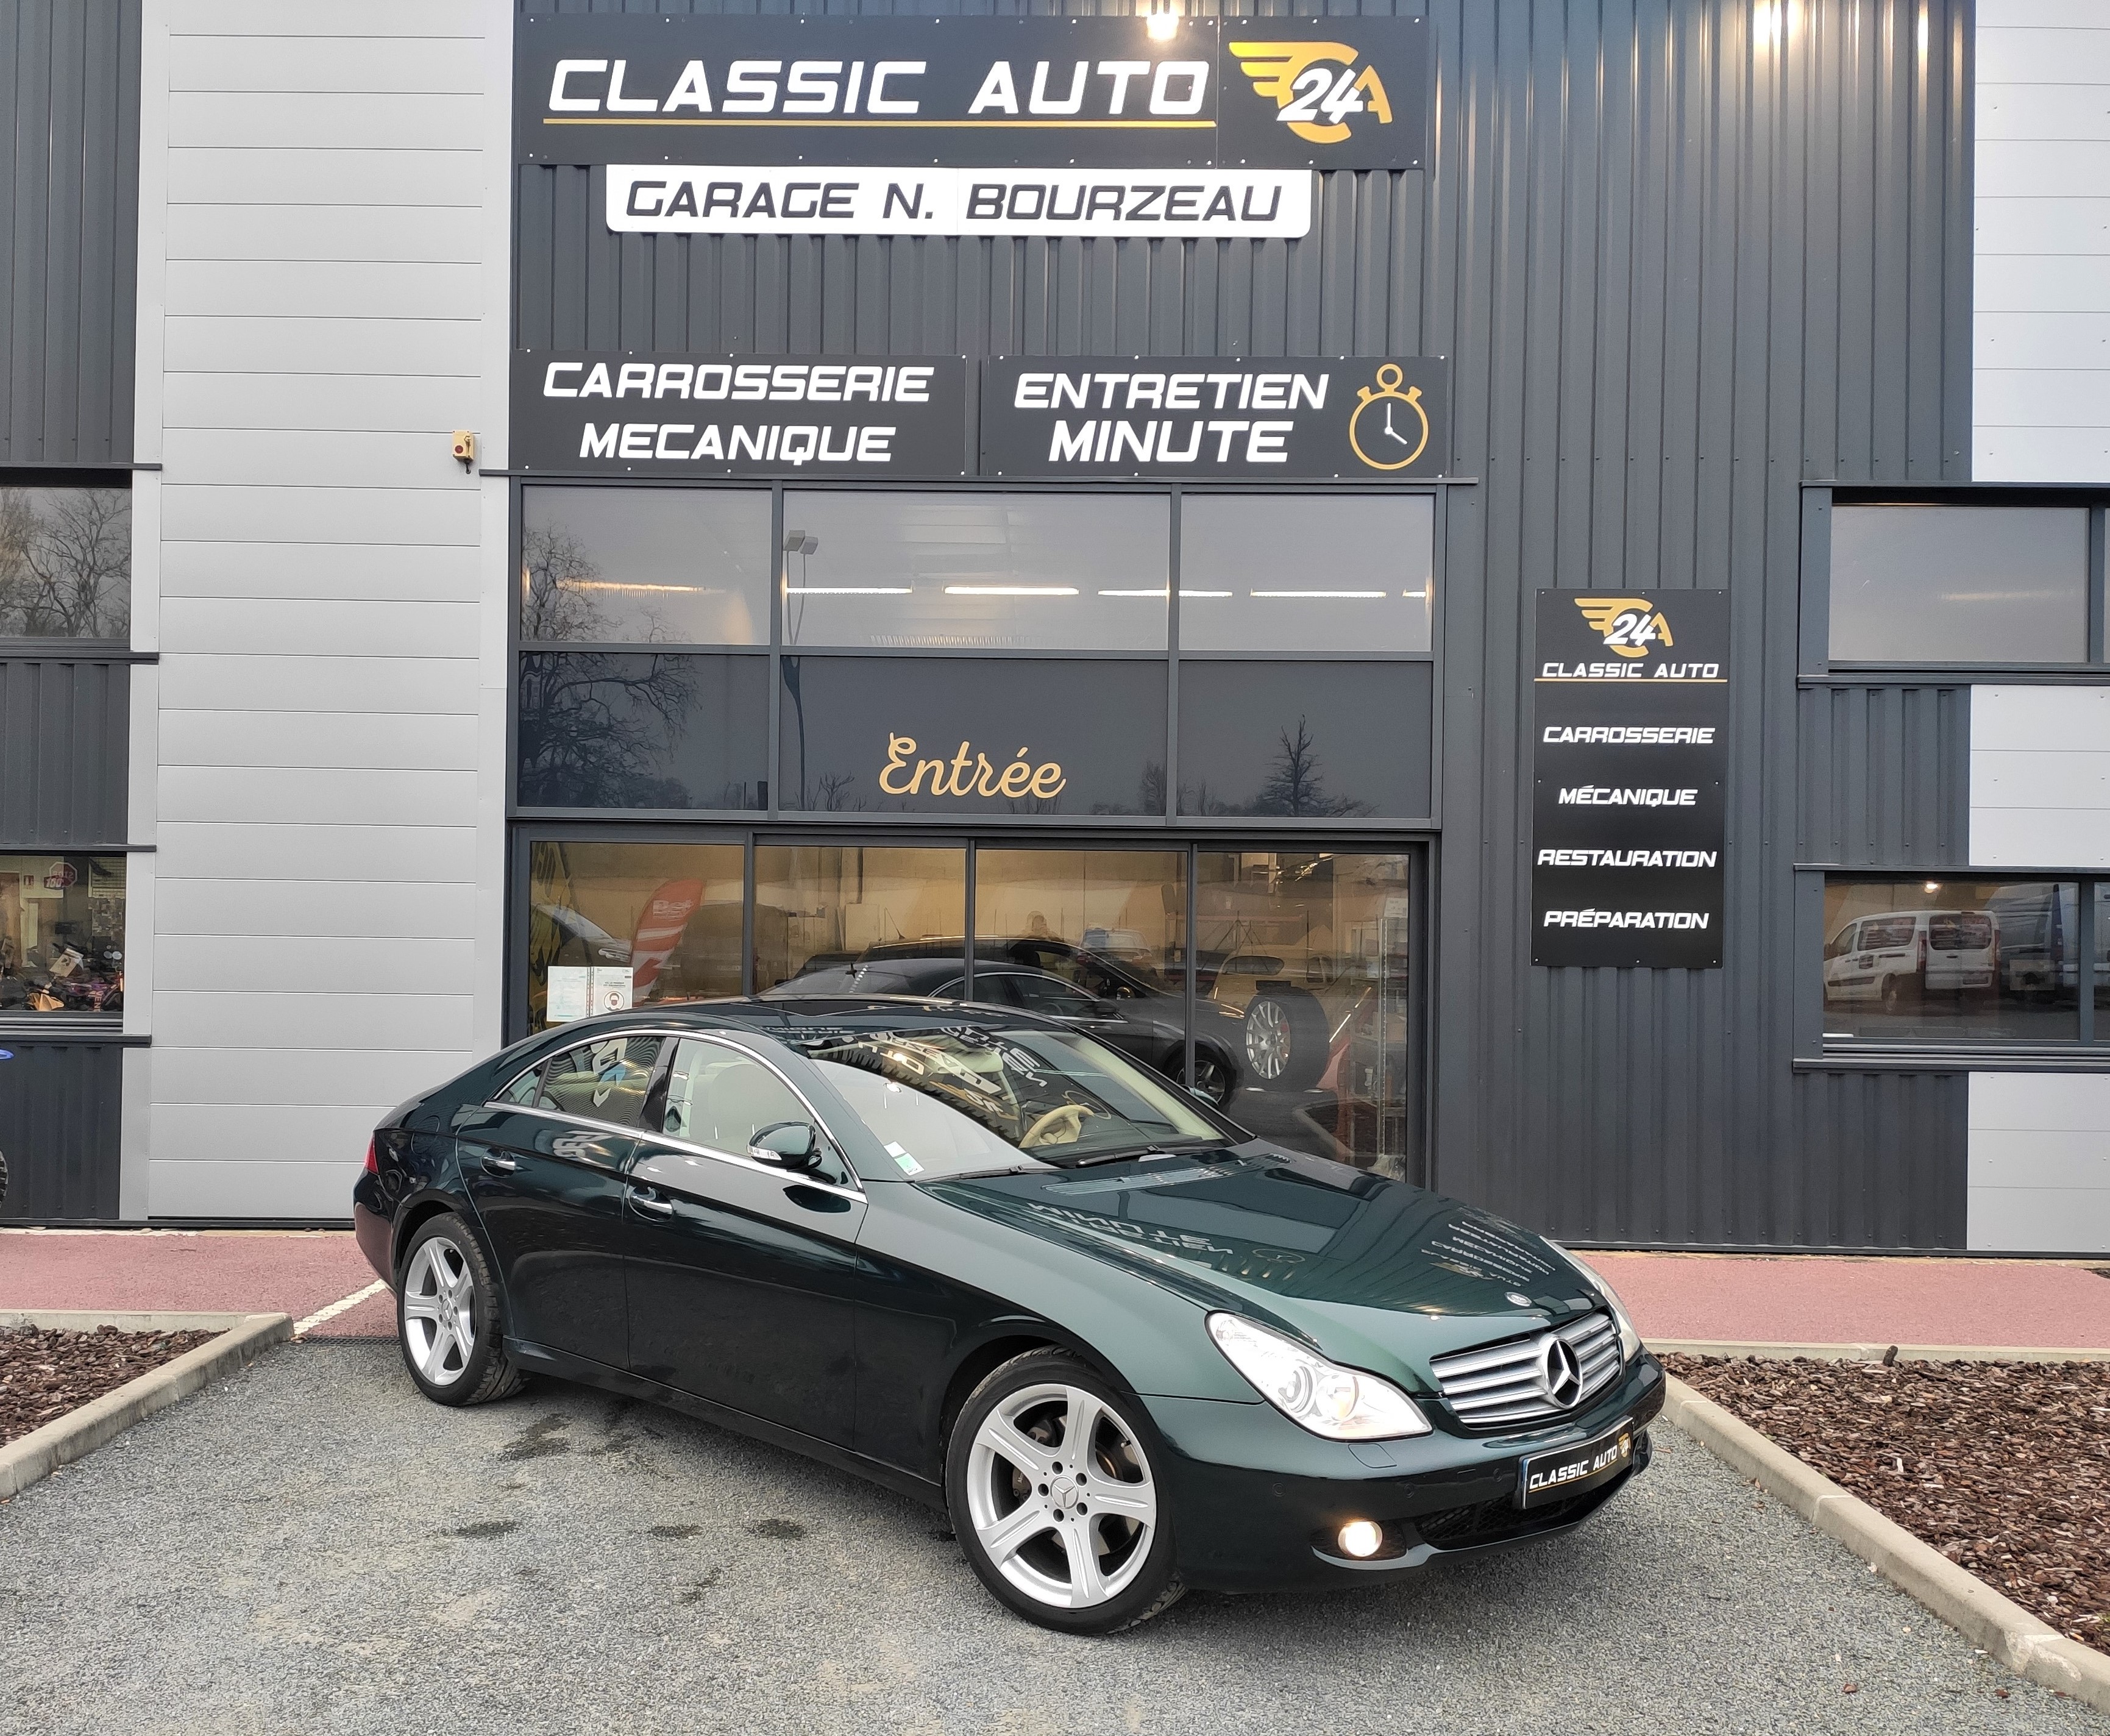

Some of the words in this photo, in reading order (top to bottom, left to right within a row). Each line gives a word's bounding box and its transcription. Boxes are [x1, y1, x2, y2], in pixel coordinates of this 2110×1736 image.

[549, 59, 926, 114] CLASSIC
[968, 60, 1210, 115] AUTO
[626, 180, 860, 219] GARAGE
[883, 183, 934, 219] N.
[965, 183, 1282, 221] BOURZEAU
[543, 361, 934, 402] CARROSSERIE
[1014, 372, 1330, 410] ENTRETIEN
[579, 422, 897, 466] MECANIQUE
[1048, 420, 1294, 463] MINUTE
[1542, 662, 1644, 678] CLASSIC
[1654, 663, 1719, 678] AUTO
[1543, 727, 1716, 744] CARROSSERIE
[879, 731, 1067, 799] Entrée
[1558, 784, 1698, 807] MÉCANIQUE
[1537, 849, 1717, 867] RESTAURATION
[1543, 908, 1710, 930] PRÉPARATION
[1529, 1459, 1589, 1490] CLASSIC
[1593, 1445, 1618, 1471] AUTO
